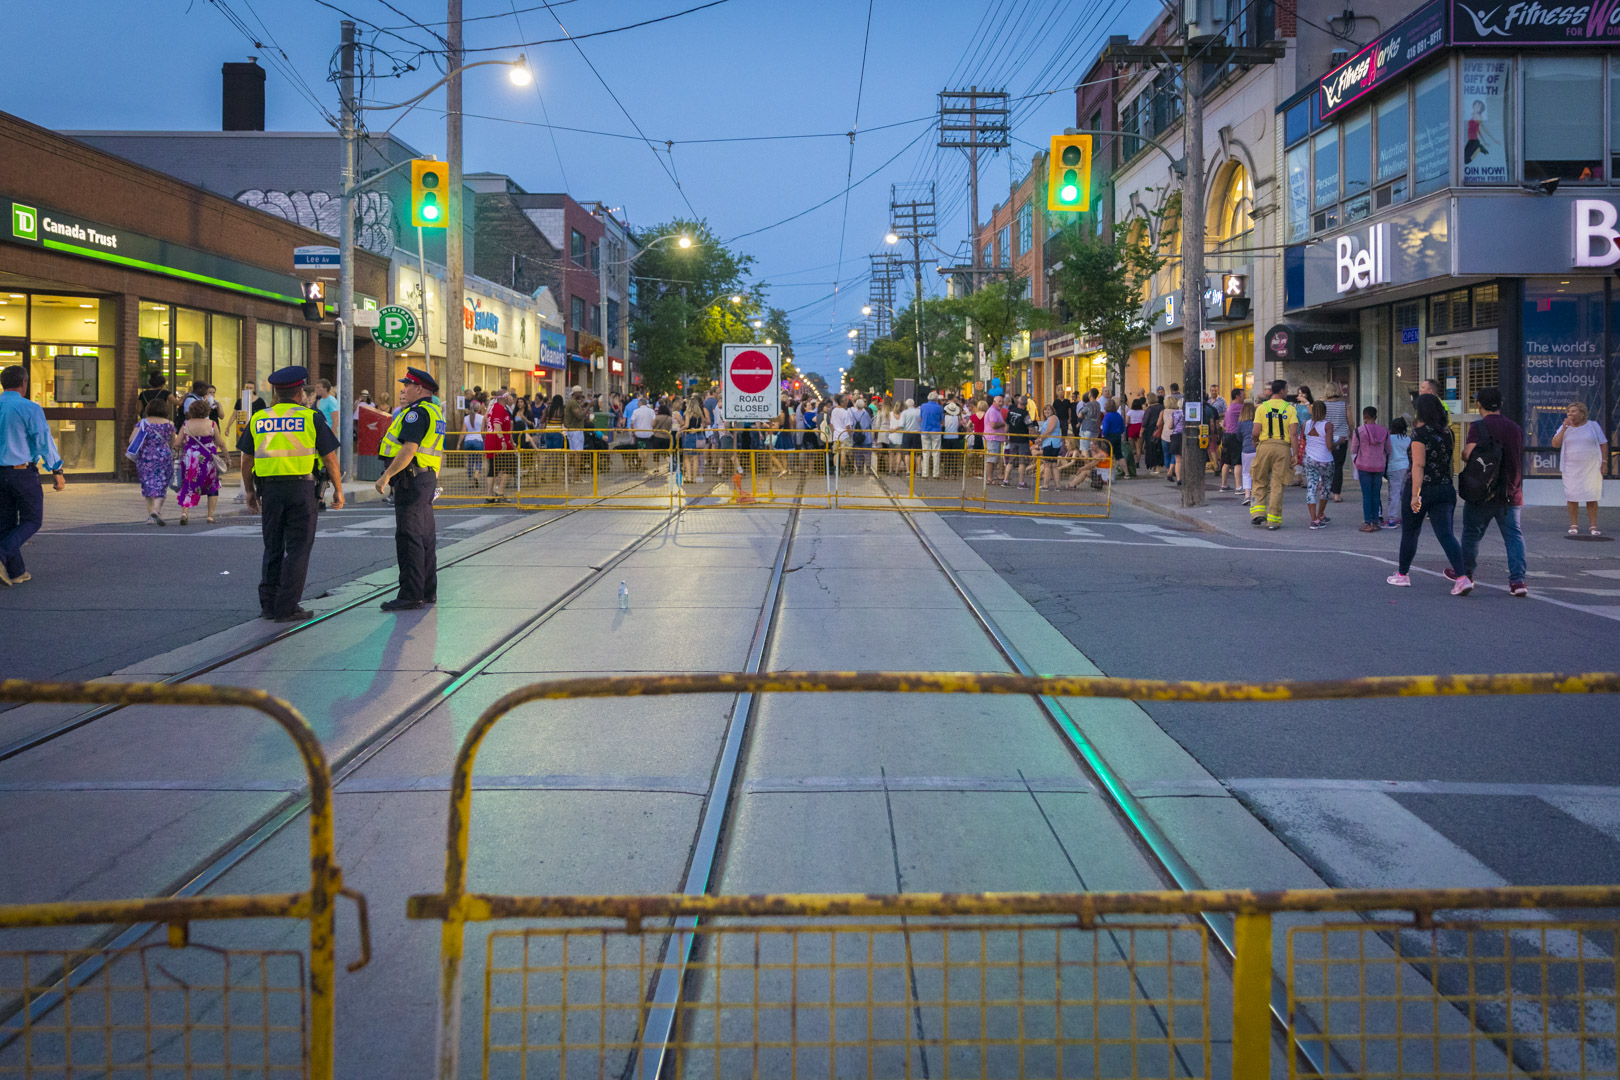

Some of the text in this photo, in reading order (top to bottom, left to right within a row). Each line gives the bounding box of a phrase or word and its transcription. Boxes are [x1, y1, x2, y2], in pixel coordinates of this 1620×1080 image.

[1505, 0, 1620, 38] FitnessWo
[1566, 27, 1583, 36] FOR
[1486, 63, 1505, 72] THE
[1464, 74, 1500, 84] GIFT OF
[1464, 86, 1498, 95] HEALTH
[1464, 166, 1505, 175] OIN NOW!
[1316, 173, 1338, 192] Persona
[15, 210, 117, 248] TD Canada Trust
[306, 255, 320, 263] Lee
[1336, 222, 1383, 293] Bell
[385, 317, 402, 335] P
[373, 331, 413, 349] PARKING
[1402, 330, 1419, 342] OPEN
[1526, 340, 1596, 353] The world's
[540, 343, 565, 366] Cleaners
[1527, 356, 1605, 368] best Internet
[1527, 372, 1598, 386] technology.
[739, 395, 764, 403] ROAD
[733, 404, 769, 412] CLOSED
[256, 418, 304, 432] POLICE
[1533, 454, 1557, 469] Bell
